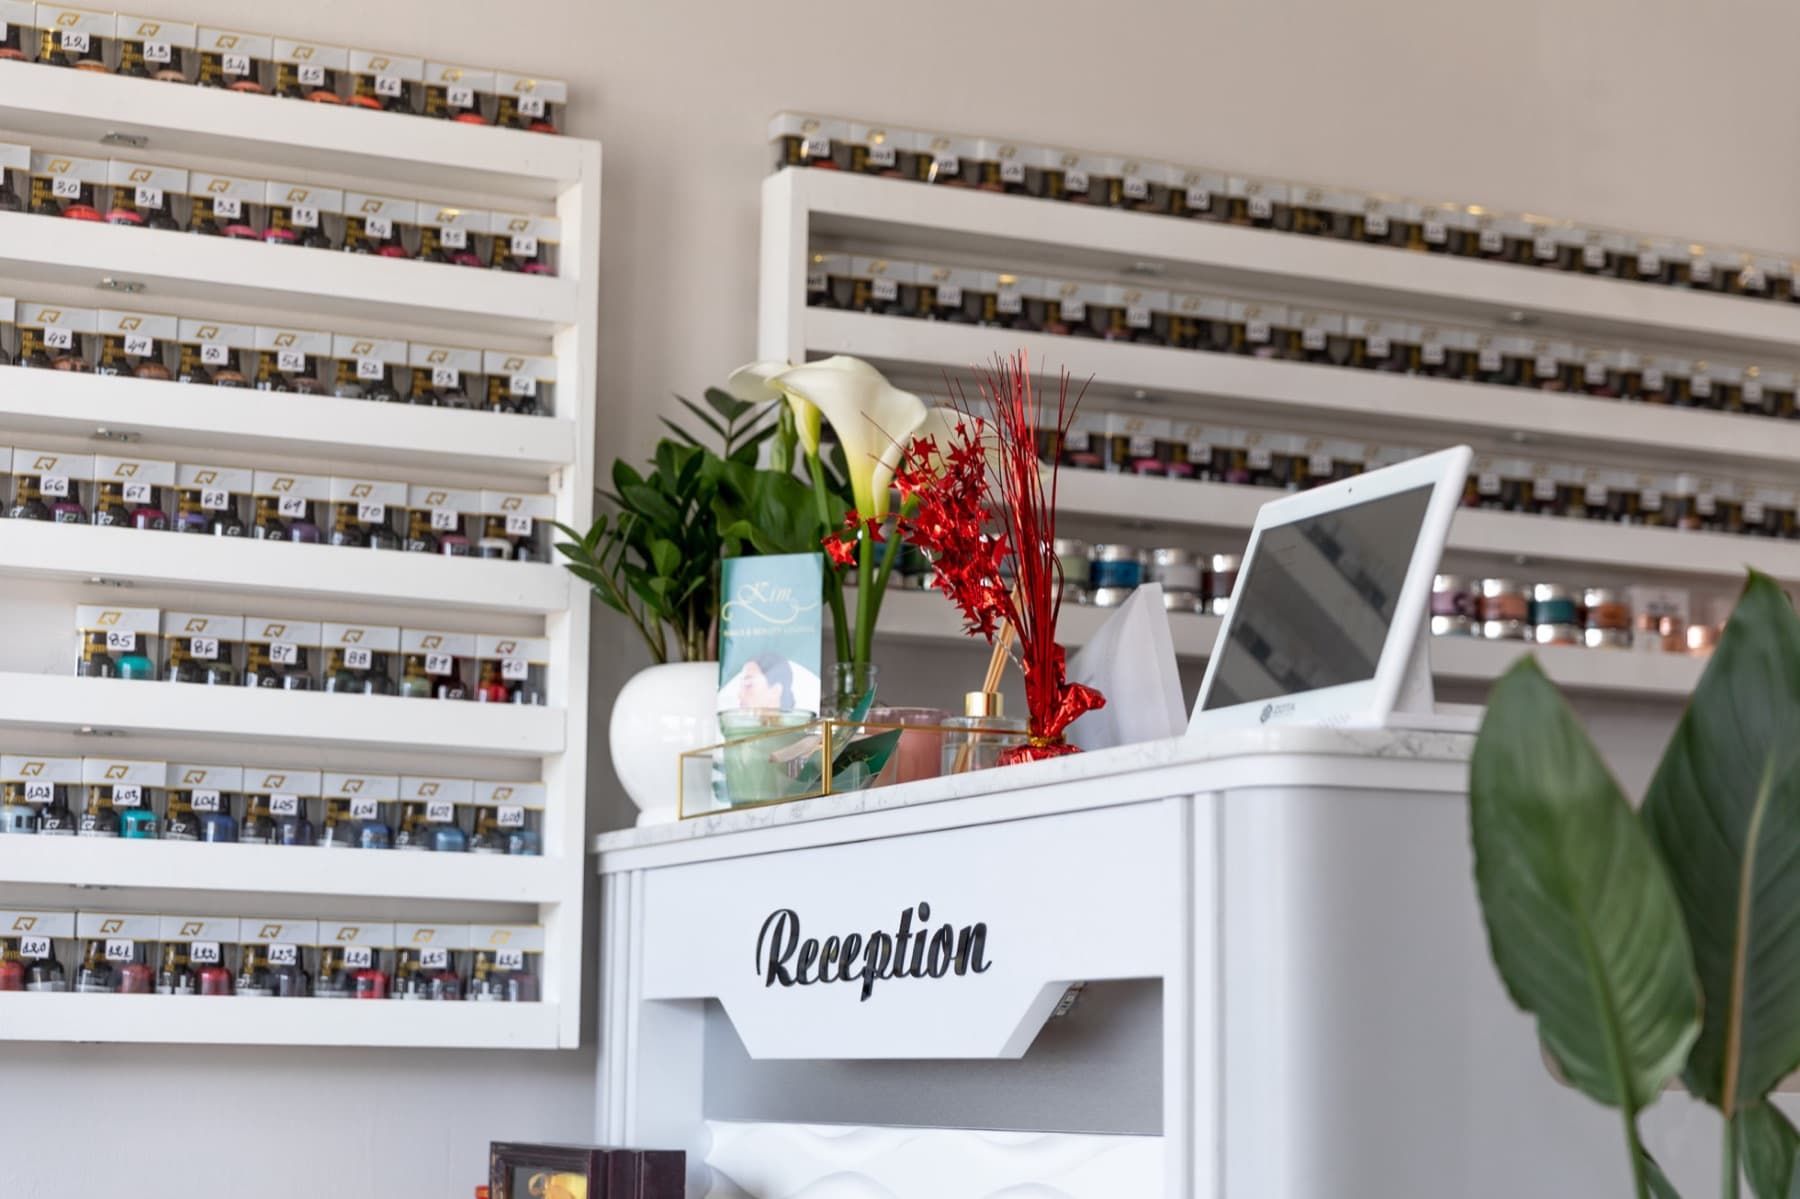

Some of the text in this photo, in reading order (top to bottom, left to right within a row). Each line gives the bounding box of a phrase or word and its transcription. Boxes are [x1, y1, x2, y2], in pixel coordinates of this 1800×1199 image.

[128, 340, 147, 353] 49
[44, 480, 64, 491] 66
[126, 487, 145, 499] 67
[204, 492, 224, 505] 68
[284, 500, 303, 512] 69
[361, 506, 381, 518] 70
[108, 633, 132, 648] 85
[272, 646, 292, 661] 87
[348, 652, 367, 665] 88
[428, 656, 448, 670] 89
[756, 901, 992, 1002] Reception
